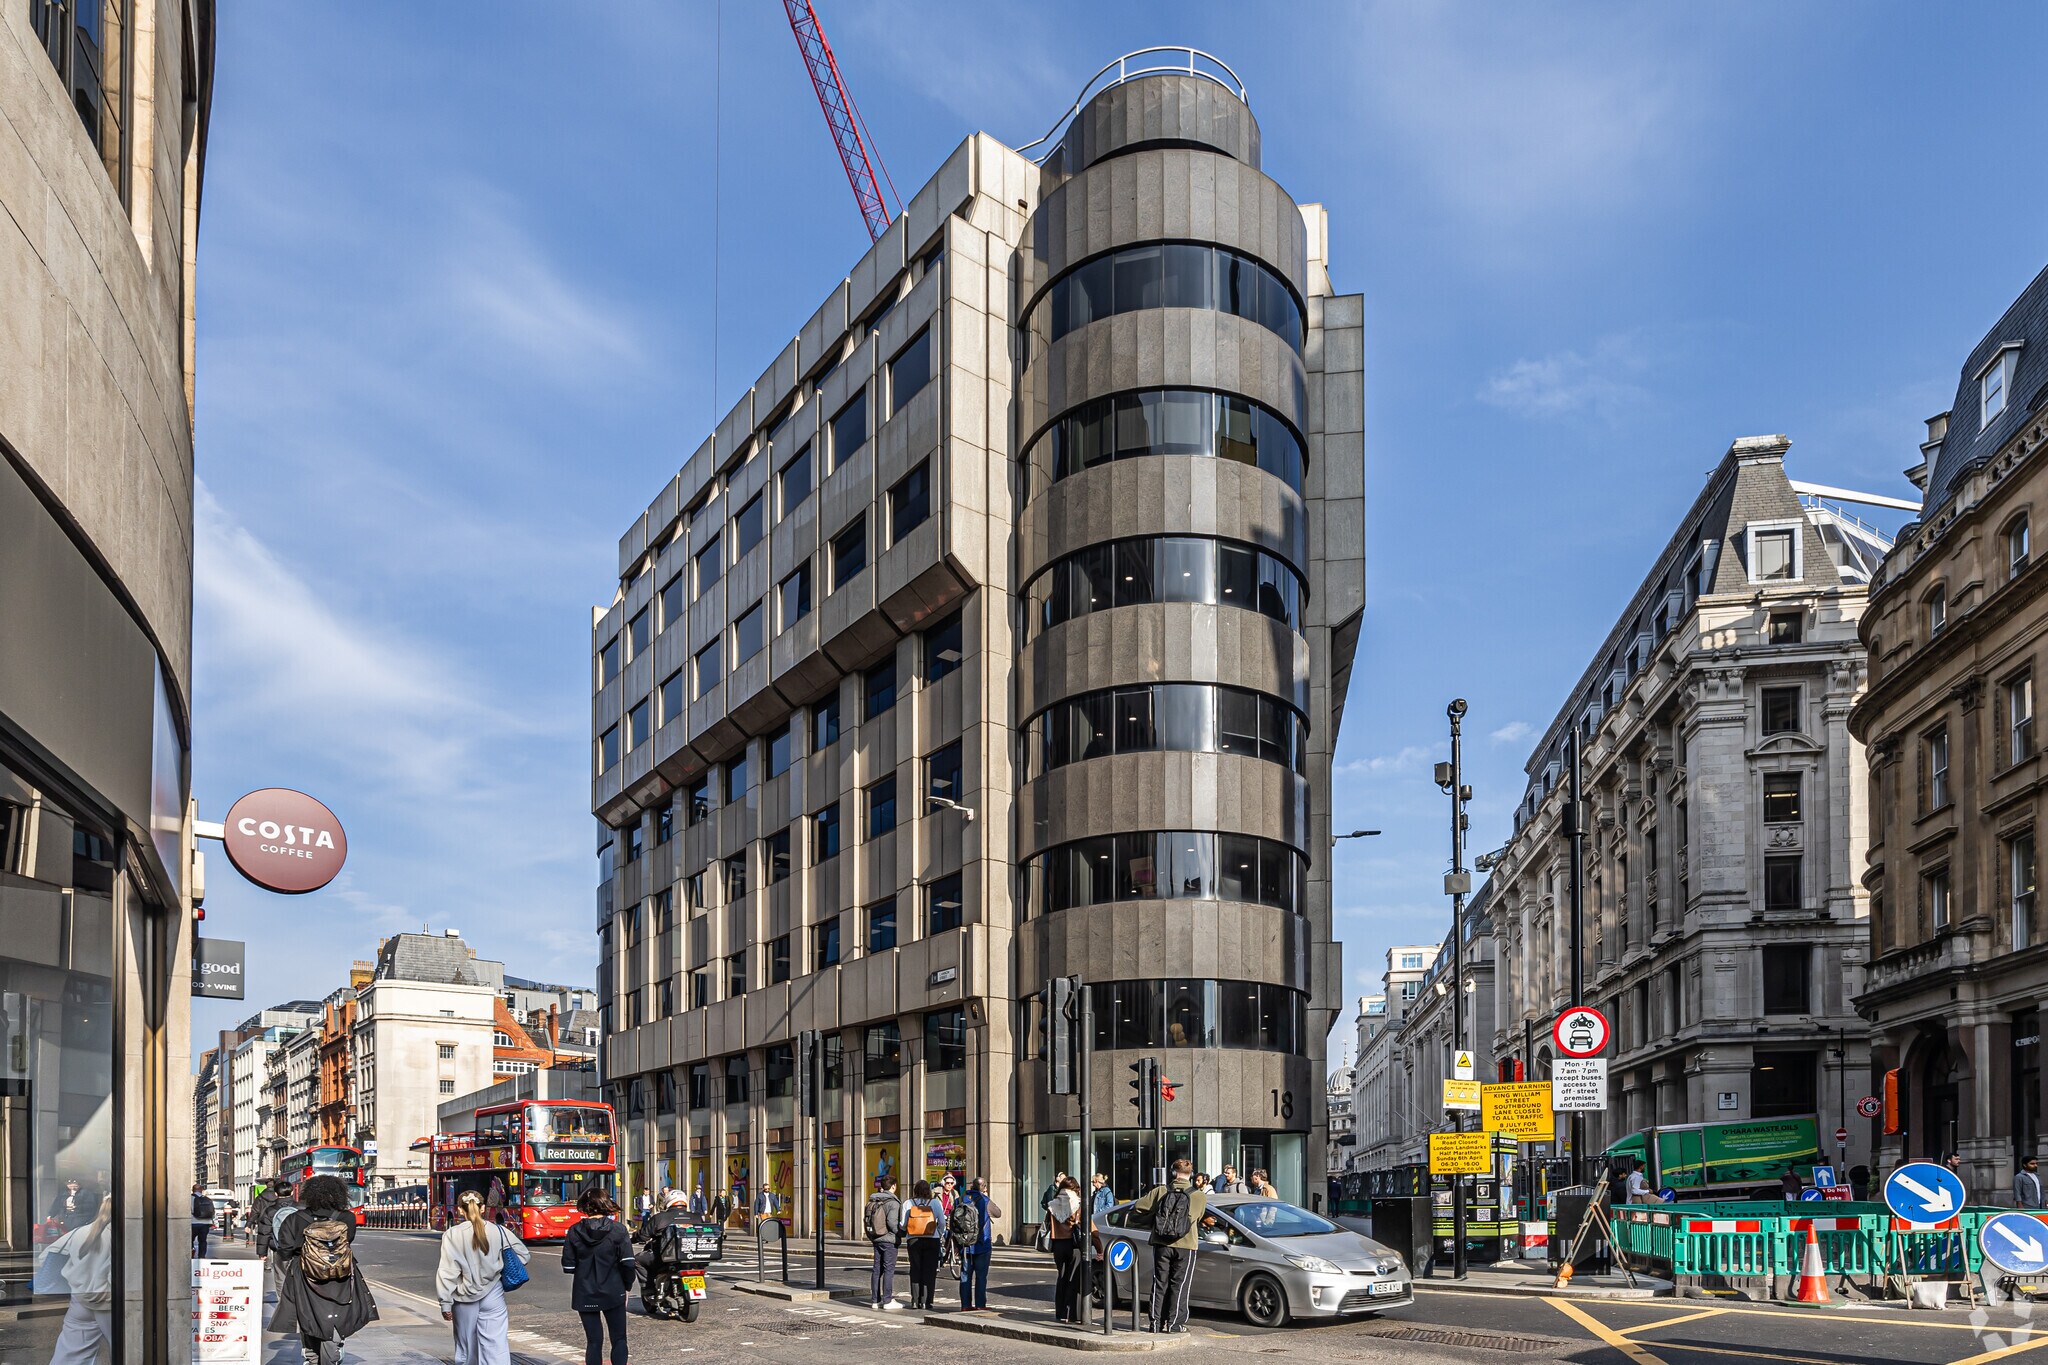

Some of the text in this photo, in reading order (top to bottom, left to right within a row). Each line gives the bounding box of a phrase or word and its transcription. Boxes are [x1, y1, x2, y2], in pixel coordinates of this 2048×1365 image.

[238, 818, 334, 849] COSTA
[260, 844, 313, 859] COFFEE
[201, 962, 240, 975] good
[214, 983, 237, 991] WINE
[1271, 1089, 1294, 1120] 18
[548, 1149, 595, 1159] Red Route
[194, 1268, 242, 1279] all good
